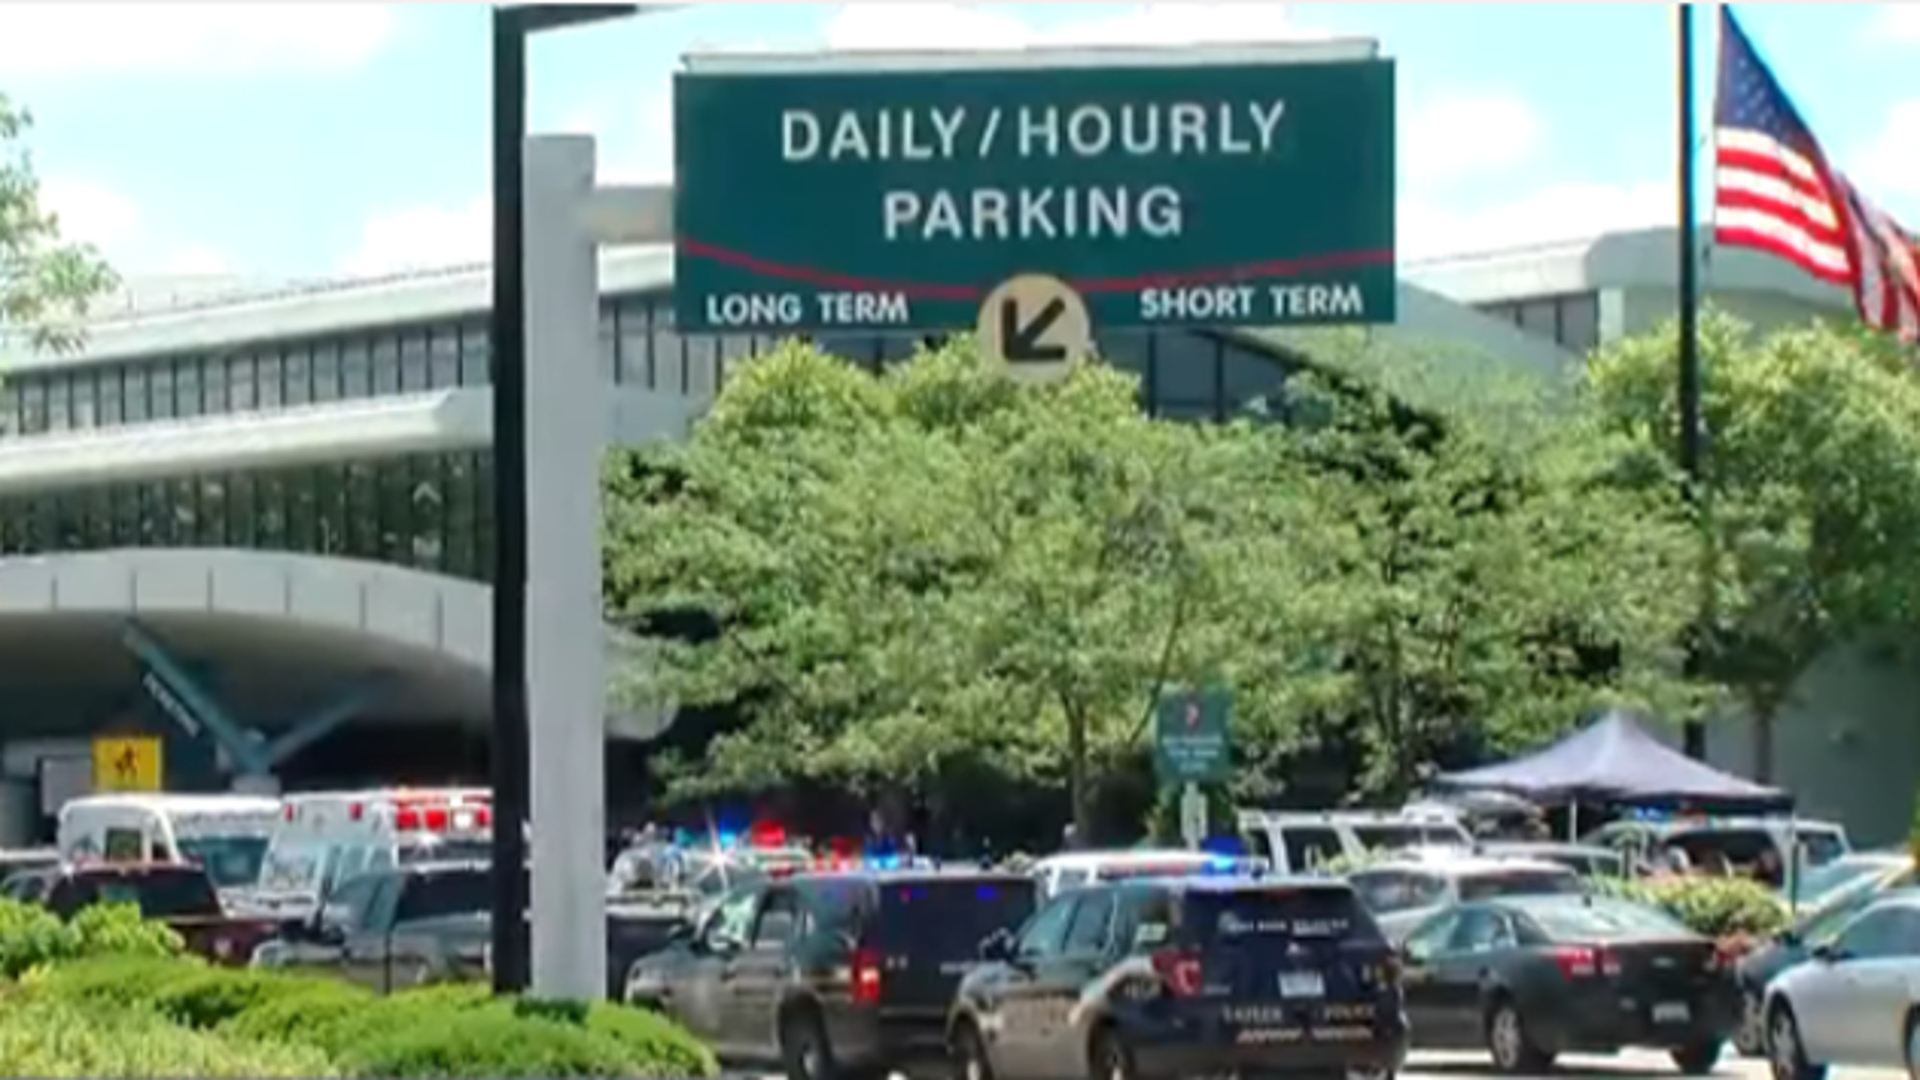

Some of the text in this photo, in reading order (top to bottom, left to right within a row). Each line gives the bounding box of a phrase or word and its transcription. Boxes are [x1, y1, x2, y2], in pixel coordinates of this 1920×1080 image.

[884, 186, 1182, 239] PARKING
[706, 292, 908, 324] LONG TERM
[1140, 285, 1363, 317] SHORT TERM
